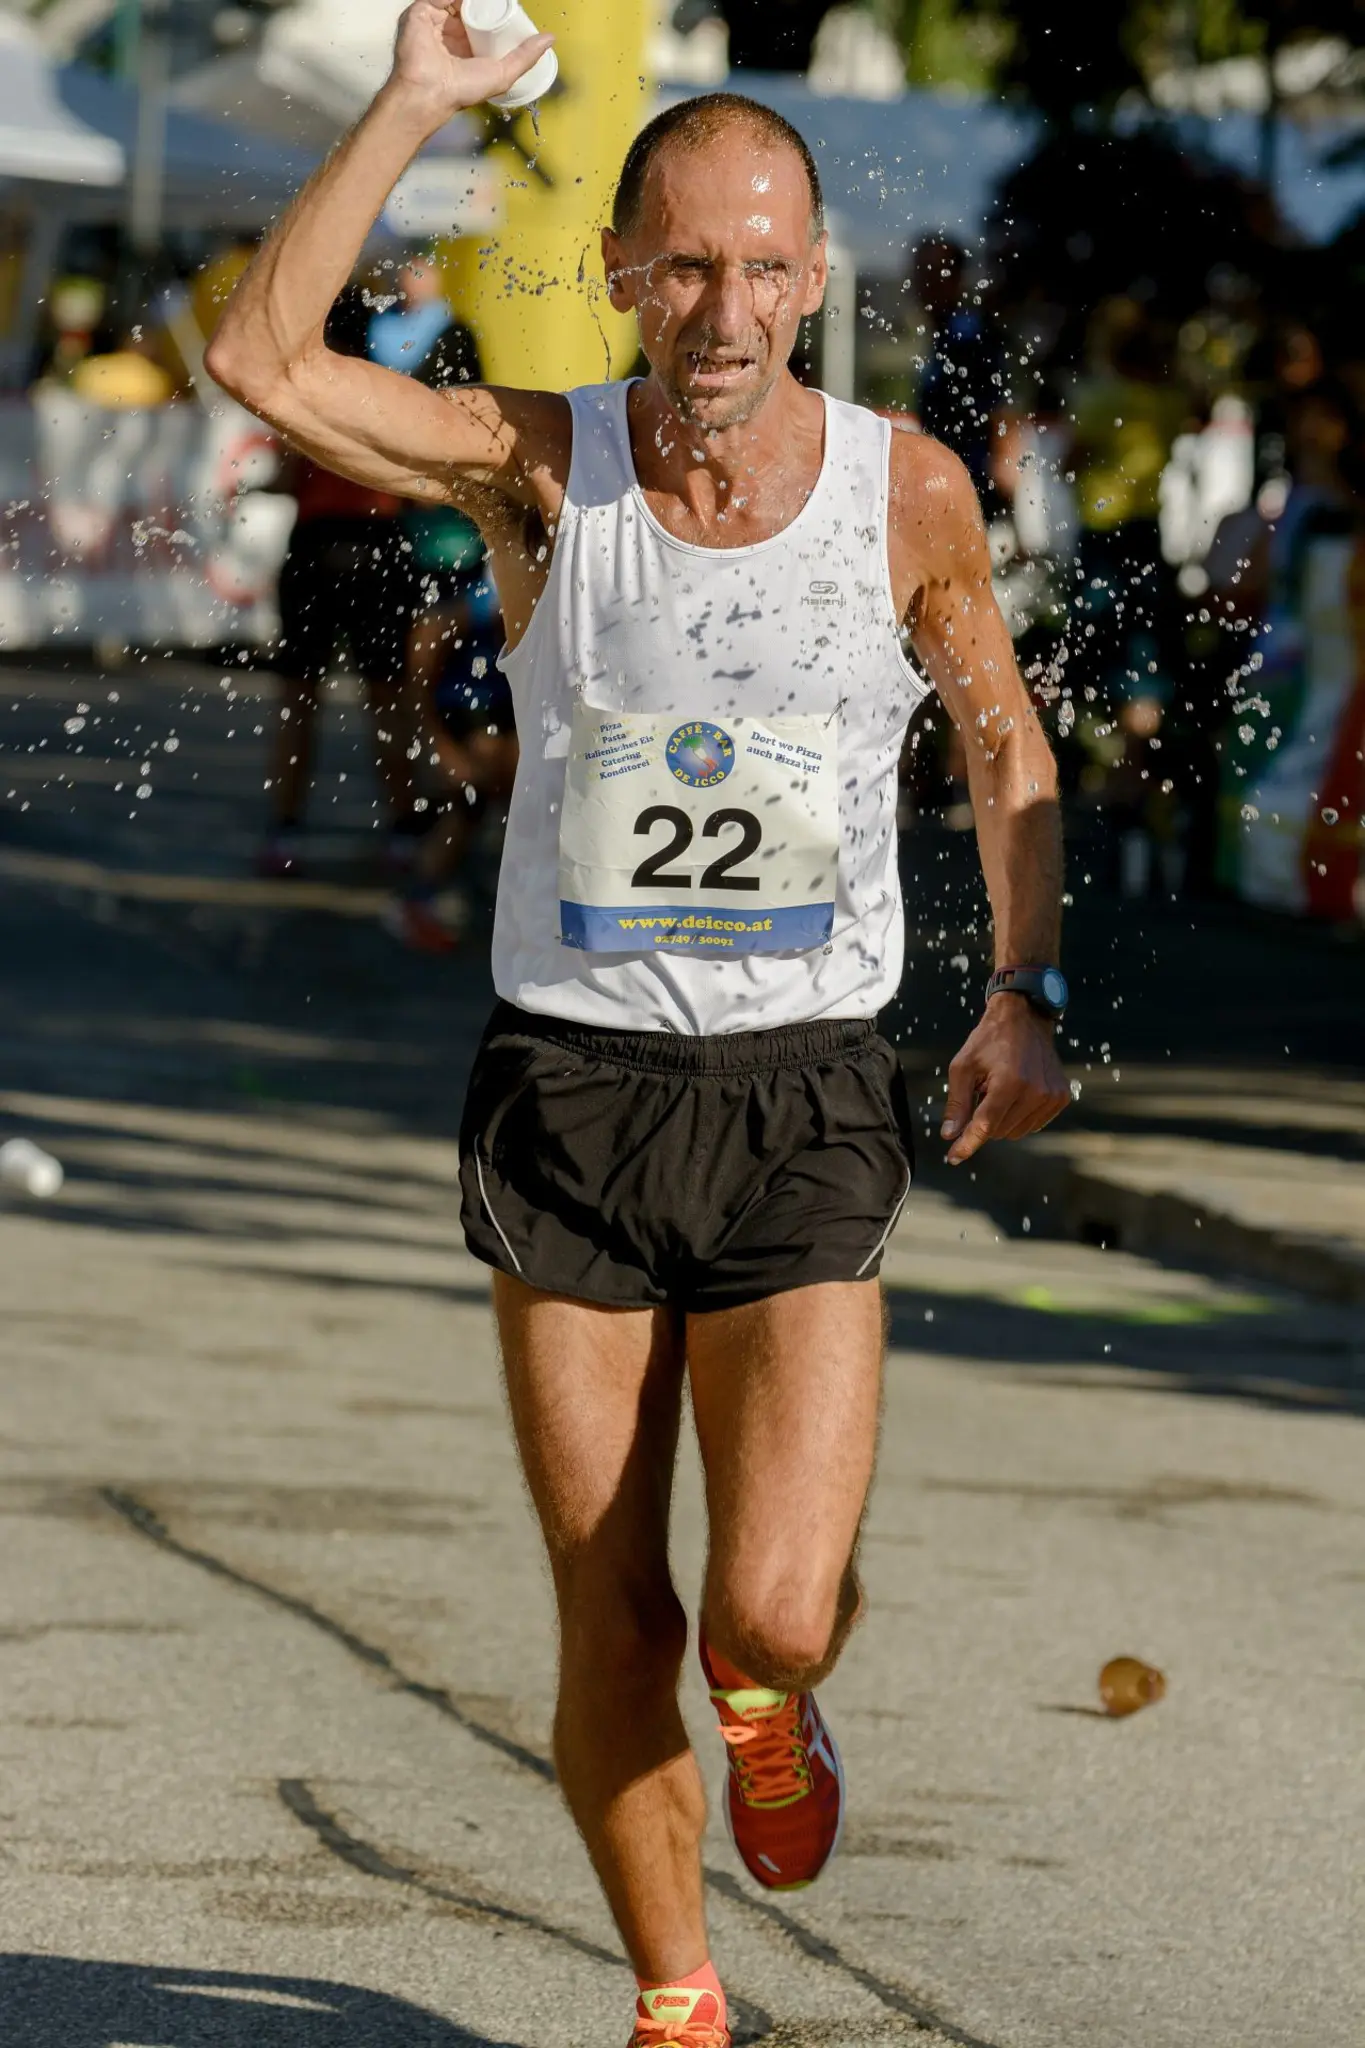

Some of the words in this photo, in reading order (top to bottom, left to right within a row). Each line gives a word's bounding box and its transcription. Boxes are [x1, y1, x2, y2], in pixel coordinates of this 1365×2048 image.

[600, 722, 622, 733] Pizza
[585, 741, 639, 760] italienisches
[640, 735, 655, 744] Eis
[602, 733, 627, 744] Pasta
[751, 731, 776, 746] Dort
[778, 741, 794, 752] wo
[795, 745, 822, 761] Pizza
[601, 751, 642, 767] Catering
[746, 745, 772, 759] auch
[774, 752, 801, 768] Pizza
[599, 759, 651, 780] Konditorei
[674, 768, 690, 783] DE
[694, 770, 725, 787] ICCO
[631, 804, 763, 891] 22
[618, 915, 773, 932] www.deicco.at
